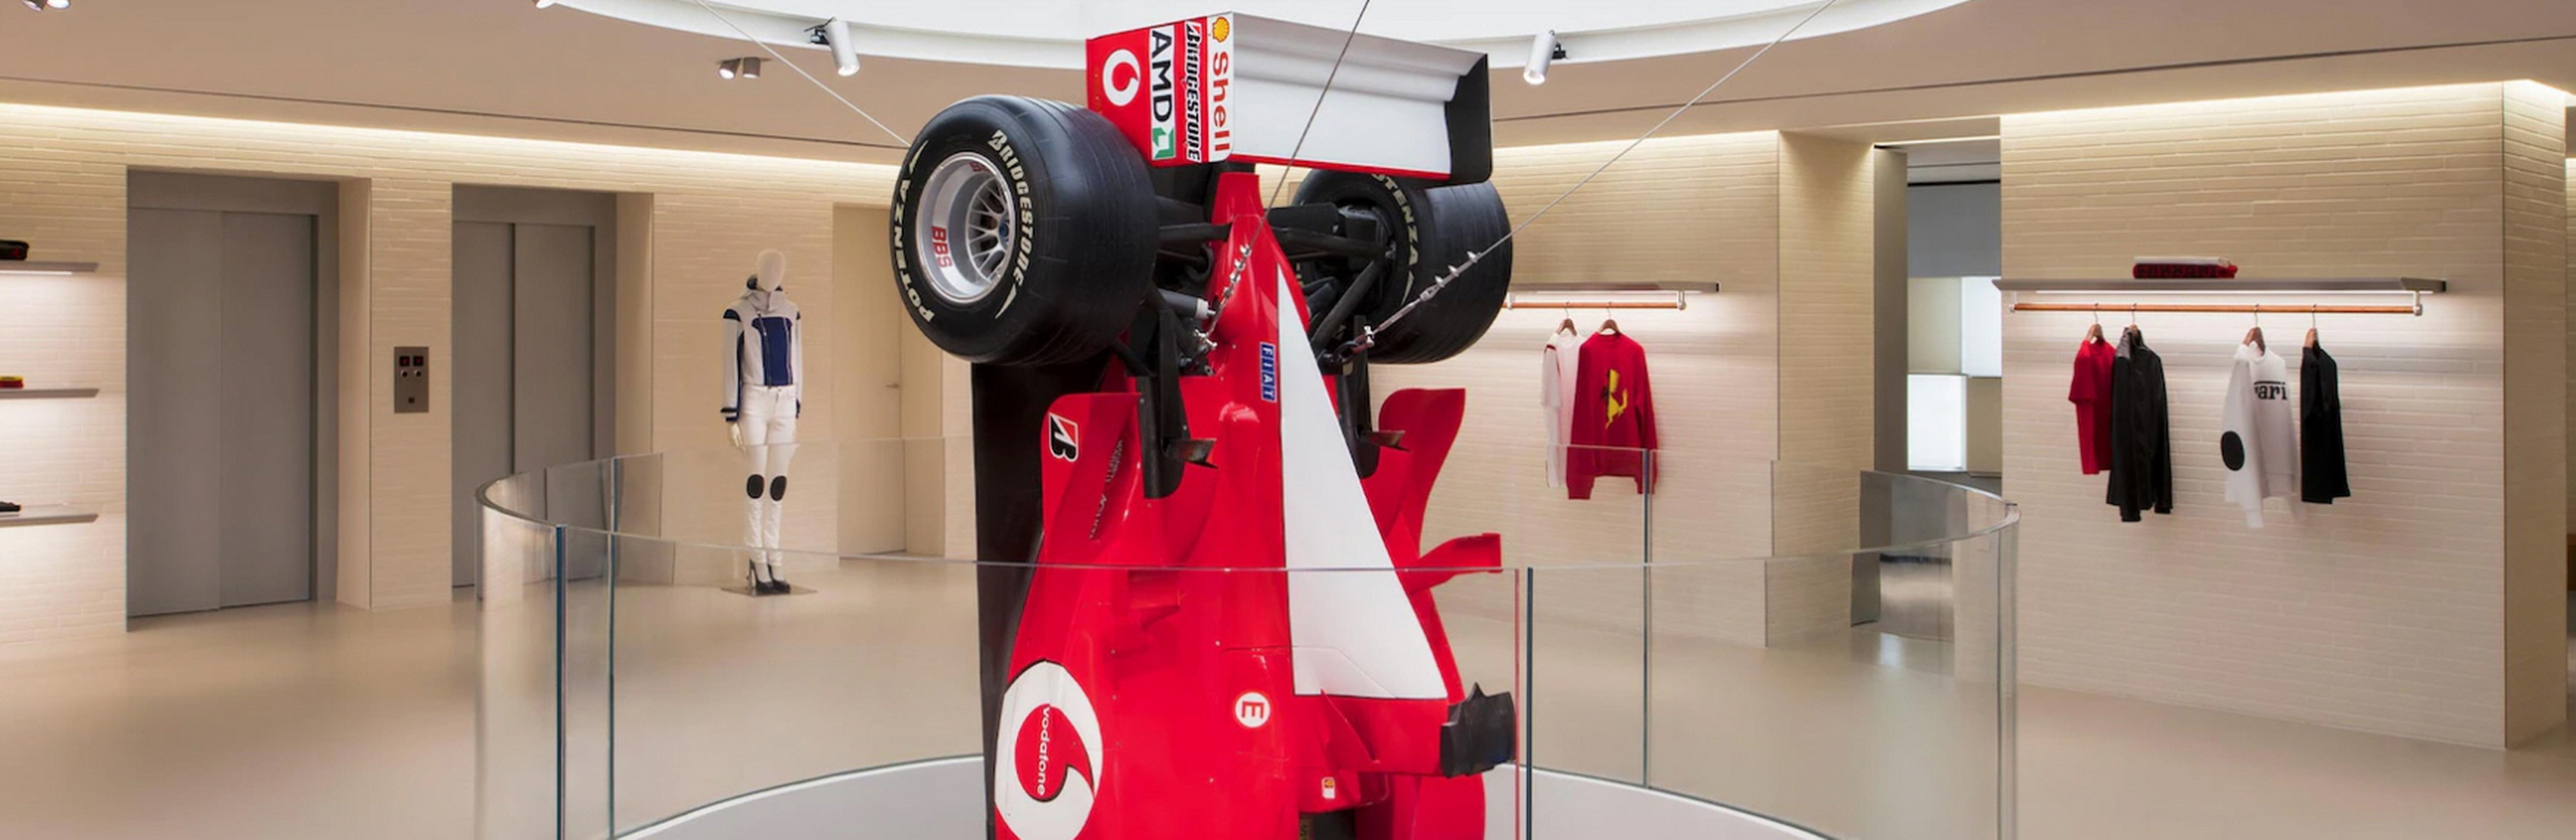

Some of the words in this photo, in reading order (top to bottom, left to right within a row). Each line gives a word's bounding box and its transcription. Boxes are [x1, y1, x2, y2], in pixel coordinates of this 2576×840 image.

[1151, 30, 1172, 122] AMD
[1185, 21, 1201, 160] BRIDGESTONE
[1213, 51, 1230, 152] Shell
[894, 179, 935, 323] POTENZA
[930, 225, 953, 267] BBS
[987, 129, 1033, 286] BRIDGESTONE
[1262, 346, 1275, 400] FIAT
[1037, 706, 1051, 796] vodafone
[1242, 701, 1265, 719] E
